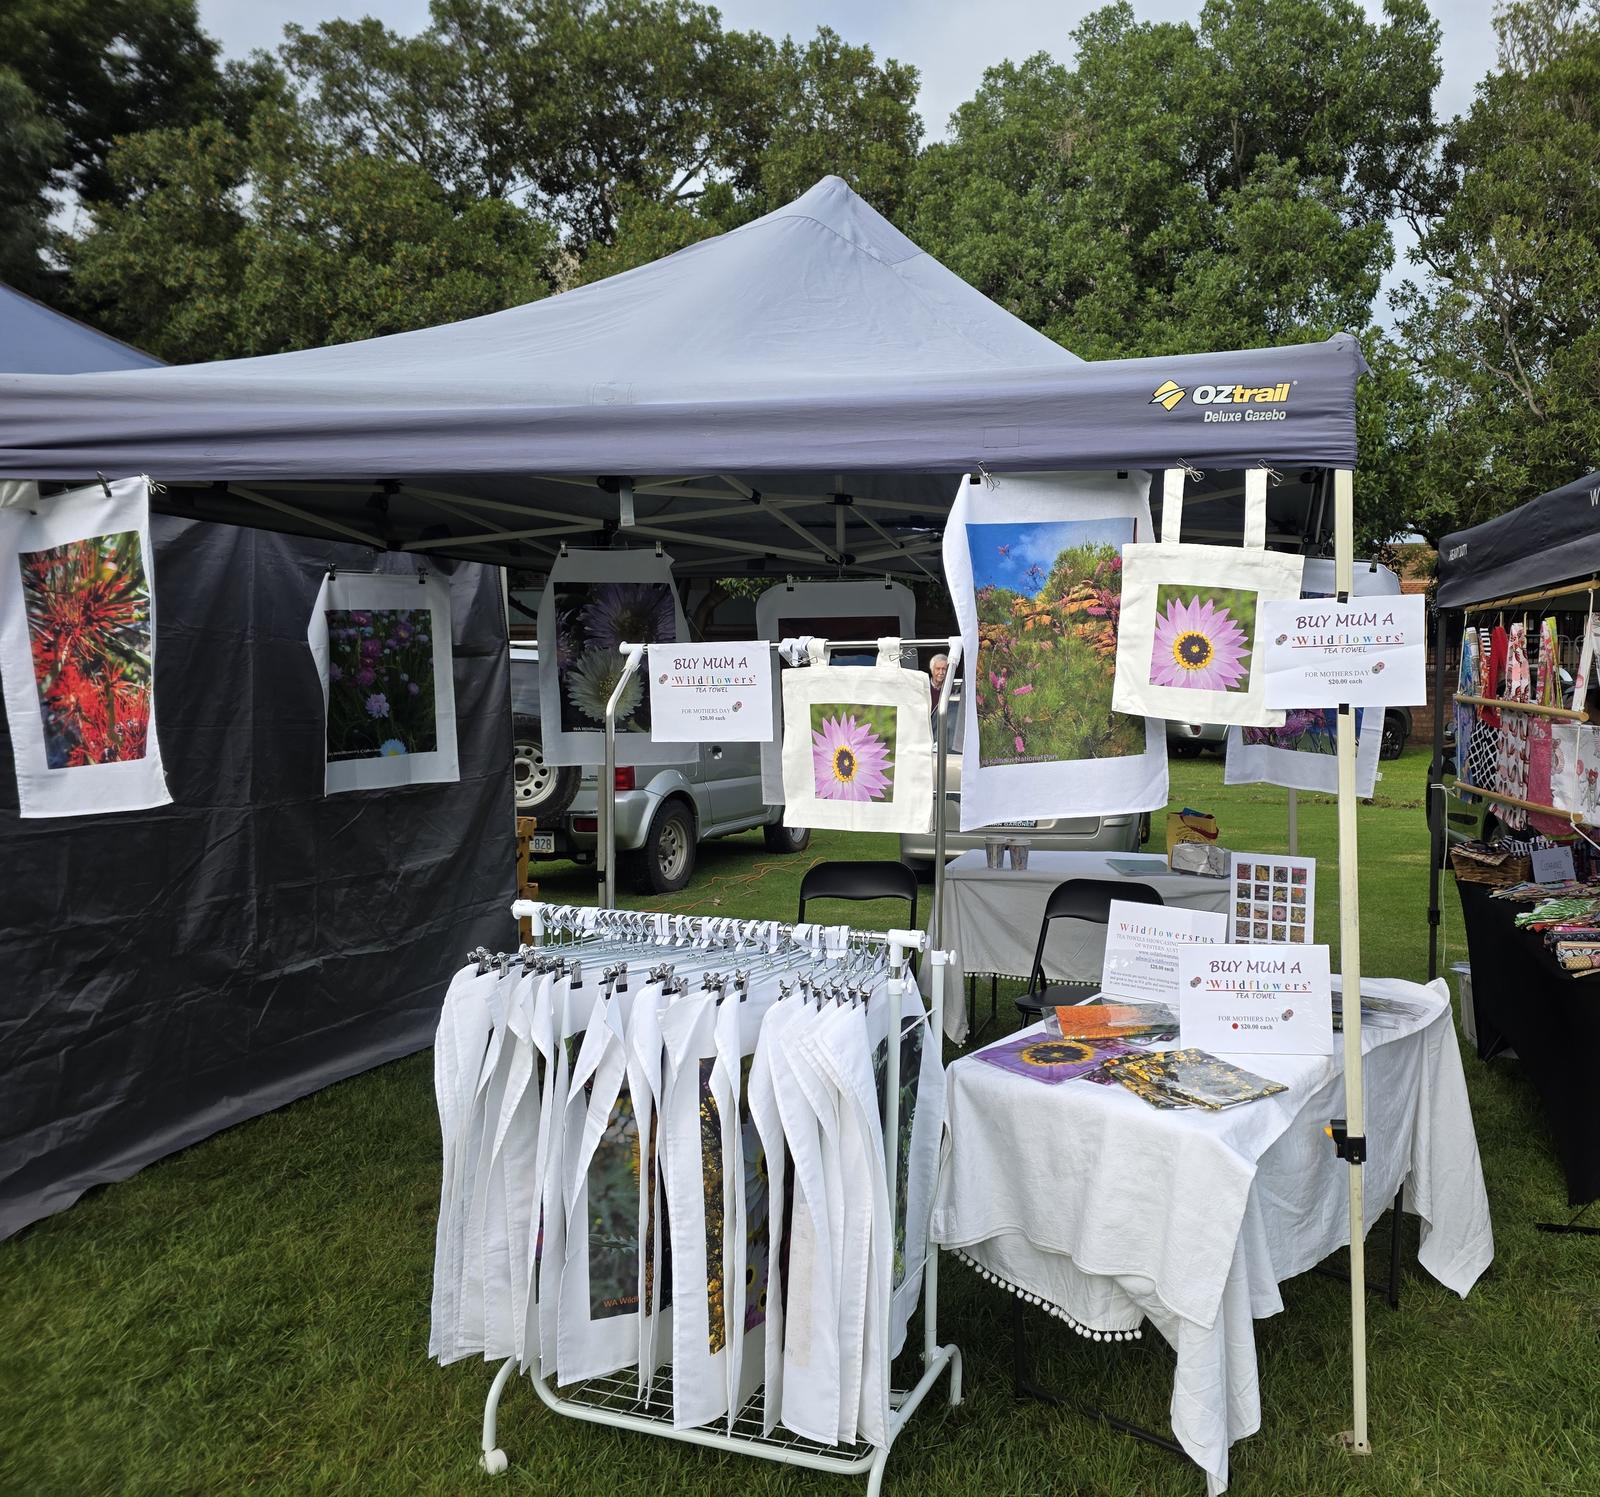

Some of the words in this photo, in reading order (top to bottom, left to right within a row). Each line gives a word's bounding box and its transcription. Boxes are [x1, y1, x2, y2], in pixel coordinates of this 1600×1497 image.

[1192, 383, 1291, 405] OZtrail
[1204, 410, 1242, 423] Deluxe
[1245, 408, 1287, 422] Gazebo
[1295, 615, 1331, 629] BUY
[1335, 612, 1377, 628] MUM
[1382, 612, 1394, 626] A
[1323, 646, 1338, 654] TEA
[1341, 646, 1367, 654] TOWEL
[673, 657, 699, 670] BUY
[702, 656, 735, 669] MUM
[738, 656, 748, 668] A
[1319, 670, 1354, 678] MOTHERS
[1354, 669, 1370, 677] DAY
[1328, 678, 1348, 686] $20.00
[1119, 922, 1215, 944] Wildflowersrus
[1209, 960, 1242, 973] BUY
[1246, 959, 1285, 974] MUM
[1290, 961, 1302, 974] A
[603, 1299, 618, 1308] WA
